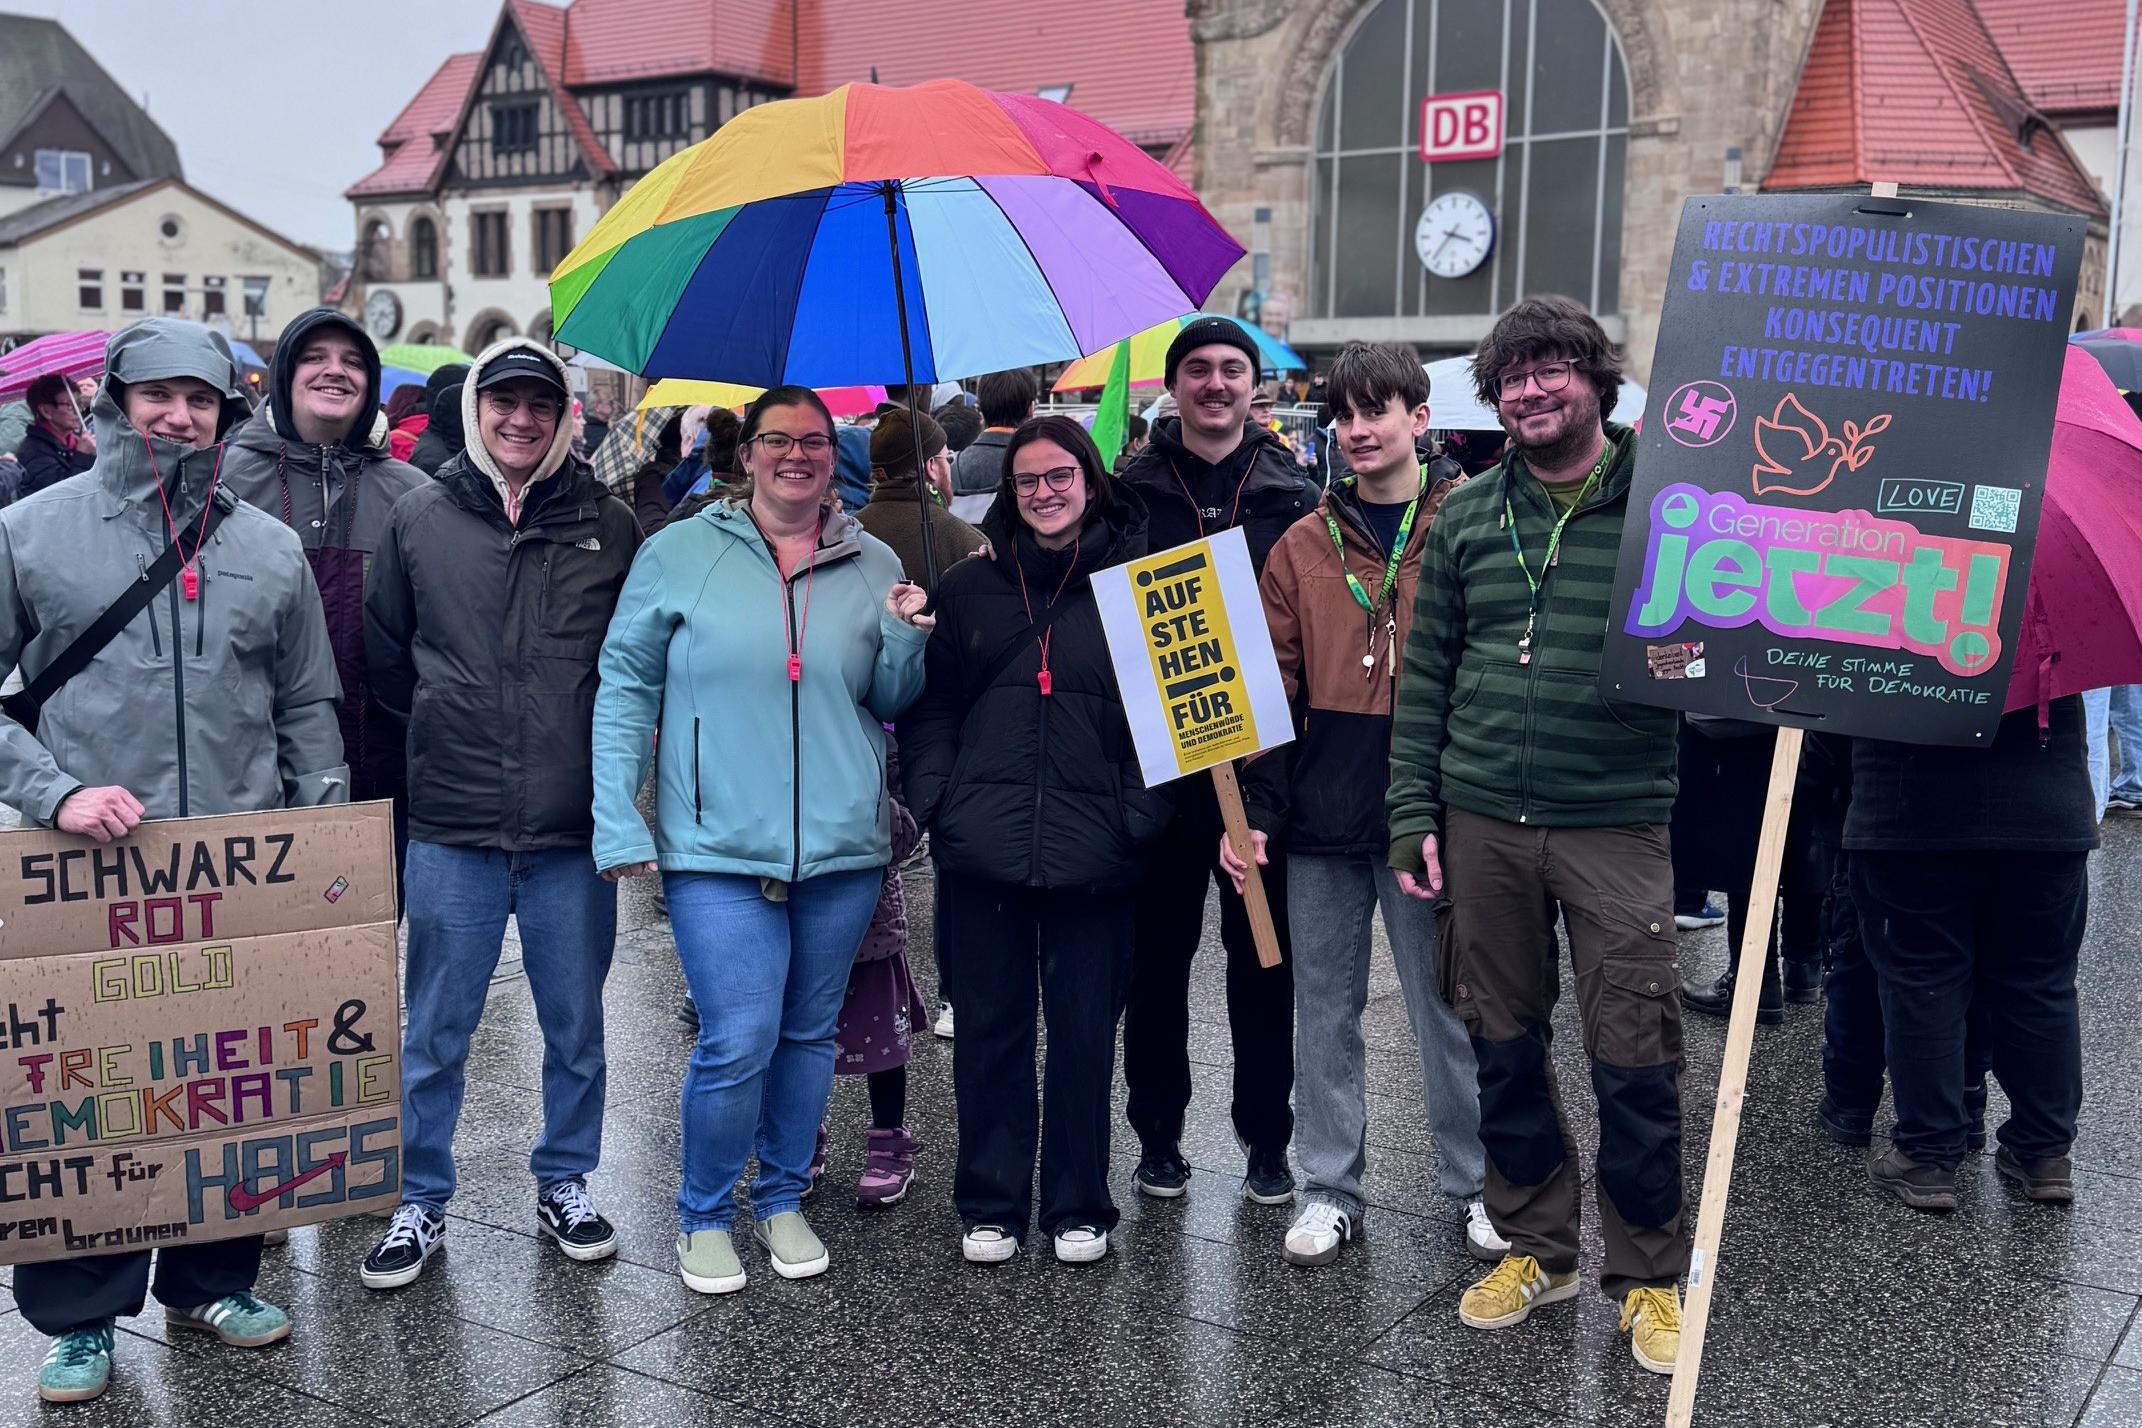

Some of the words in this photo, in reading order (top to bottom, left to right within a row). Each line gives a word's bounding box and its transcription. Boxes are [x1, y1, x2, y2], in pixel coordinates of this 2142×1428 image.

[1432, 104, 1490, 148] DB
[1703, 219, 2056, 278] RECHTSPOPULISTISCHEN
[1686, 258, 1708, 292] &
[1717, 260, 1870, 304] EXTREMEN
[1878, 271, 2058, 322] POSITIONEN
[1764, 306, 1961, 355] KONSEQUENT
[1719, 345, 1992, 402] ENTGEGENTRETEN!
[1887, 487, 1960, 508] LOVE
[1708, 503, 1905, 555] Generation
[1146, 575, 1202, 619] AUF
[1637, 492, 2002, 668] jetzt!
[1151, 610, 1209, 648] STE
[1158, 638, 1224, 680] HEN
[1171, 691, 1233, 730] FÜR
[1817, 672, 1853, 692] FÜR
[1868, 676, 1991, 704] DEMOKRATIE
[1178, 713, 1245, 740] MENSCHENWÜRDE
[1180, 738, 1197, 749] UND
[1197, 724, 1244, 744] DEMOKRATIE
[20, 833, 296, 904] SCHWARZ
[108, 892, 223, 948] ROT
[92, 945, 234, 1004] GOLD
[18, 1018, 320, 1094] FREIHEIT
[326, 999, 376, 1056] &
[0, 1054, 393, 1153] EMOKRATIE
[107, 1152, 164, 1192] für
[184, 1118, 399, 1225] HASS
[62, 1218, 188, 1252] braunen
